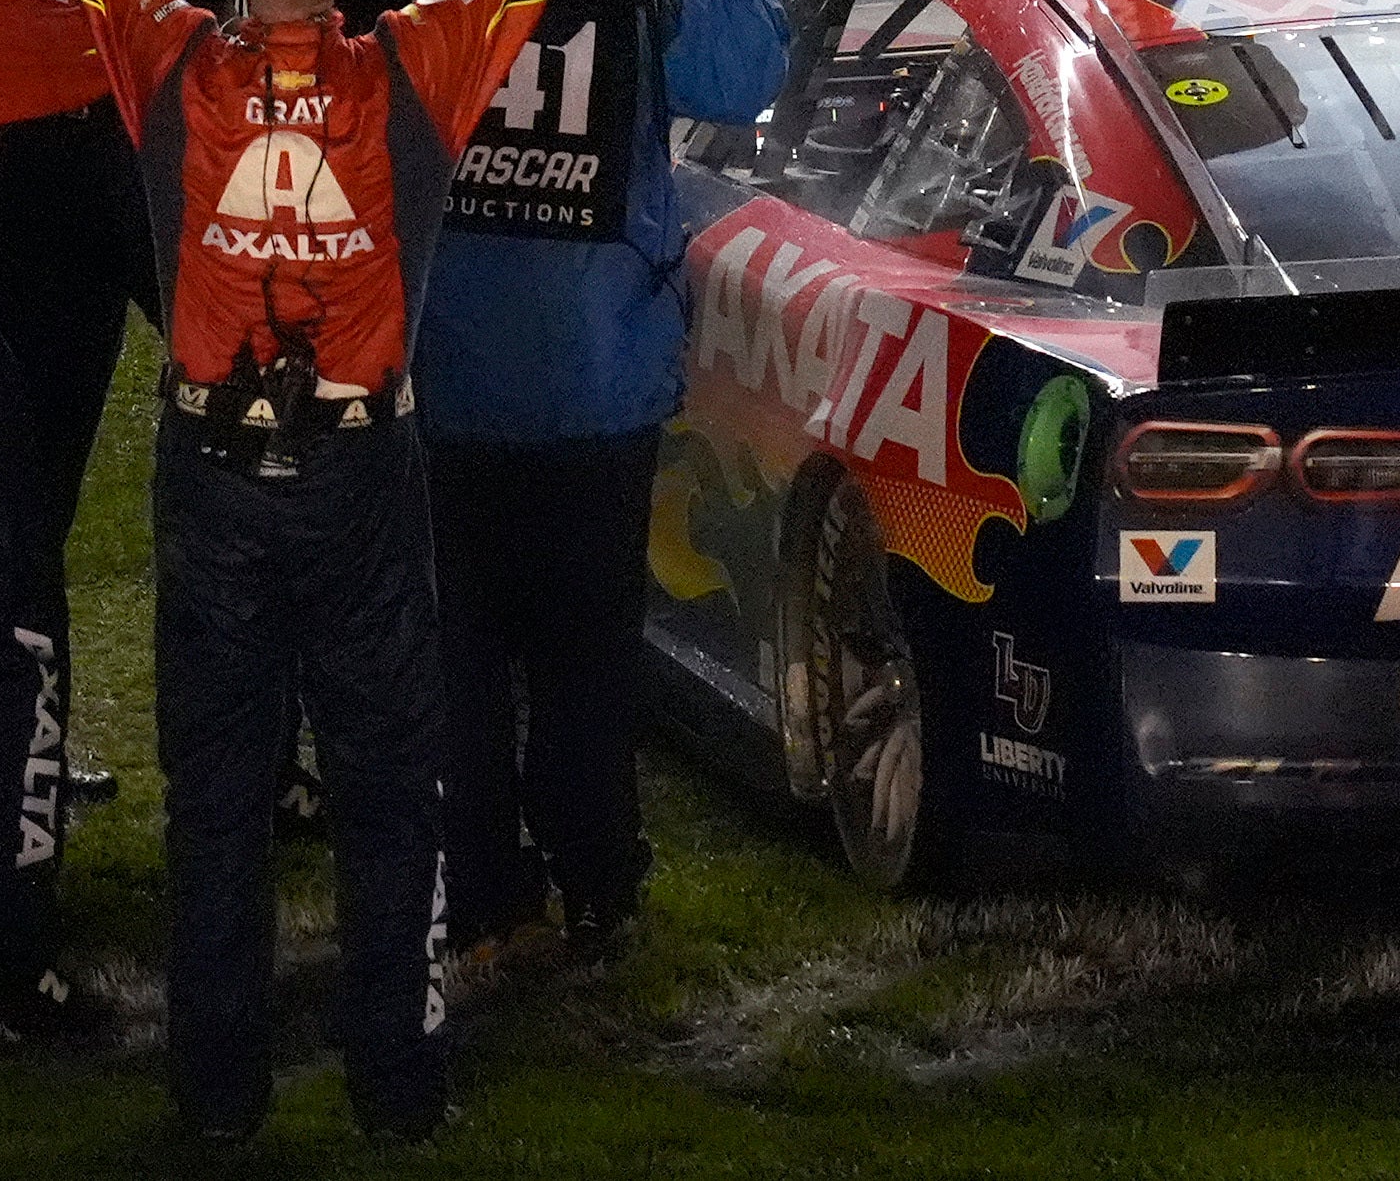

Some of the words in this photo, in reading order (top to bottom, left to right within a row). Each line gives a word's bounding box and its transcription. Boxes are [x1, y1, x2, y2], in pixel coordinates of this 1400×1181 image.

[489, 21, 597, 135] 41
[245, 95, 333, 125] GRAY
[453, 144, 600, 193] ASCAR
[201, 222, 375, 261] AXALTA
[1027, 250, 1075, 276] Valvoline
[692, 225, 948, 488] AXATA
[1130, 581, 1203, 595] Valvoline
[13, 626, 62, 869] AXALTA
[980, 731, 1065, 784] LIBERTY
